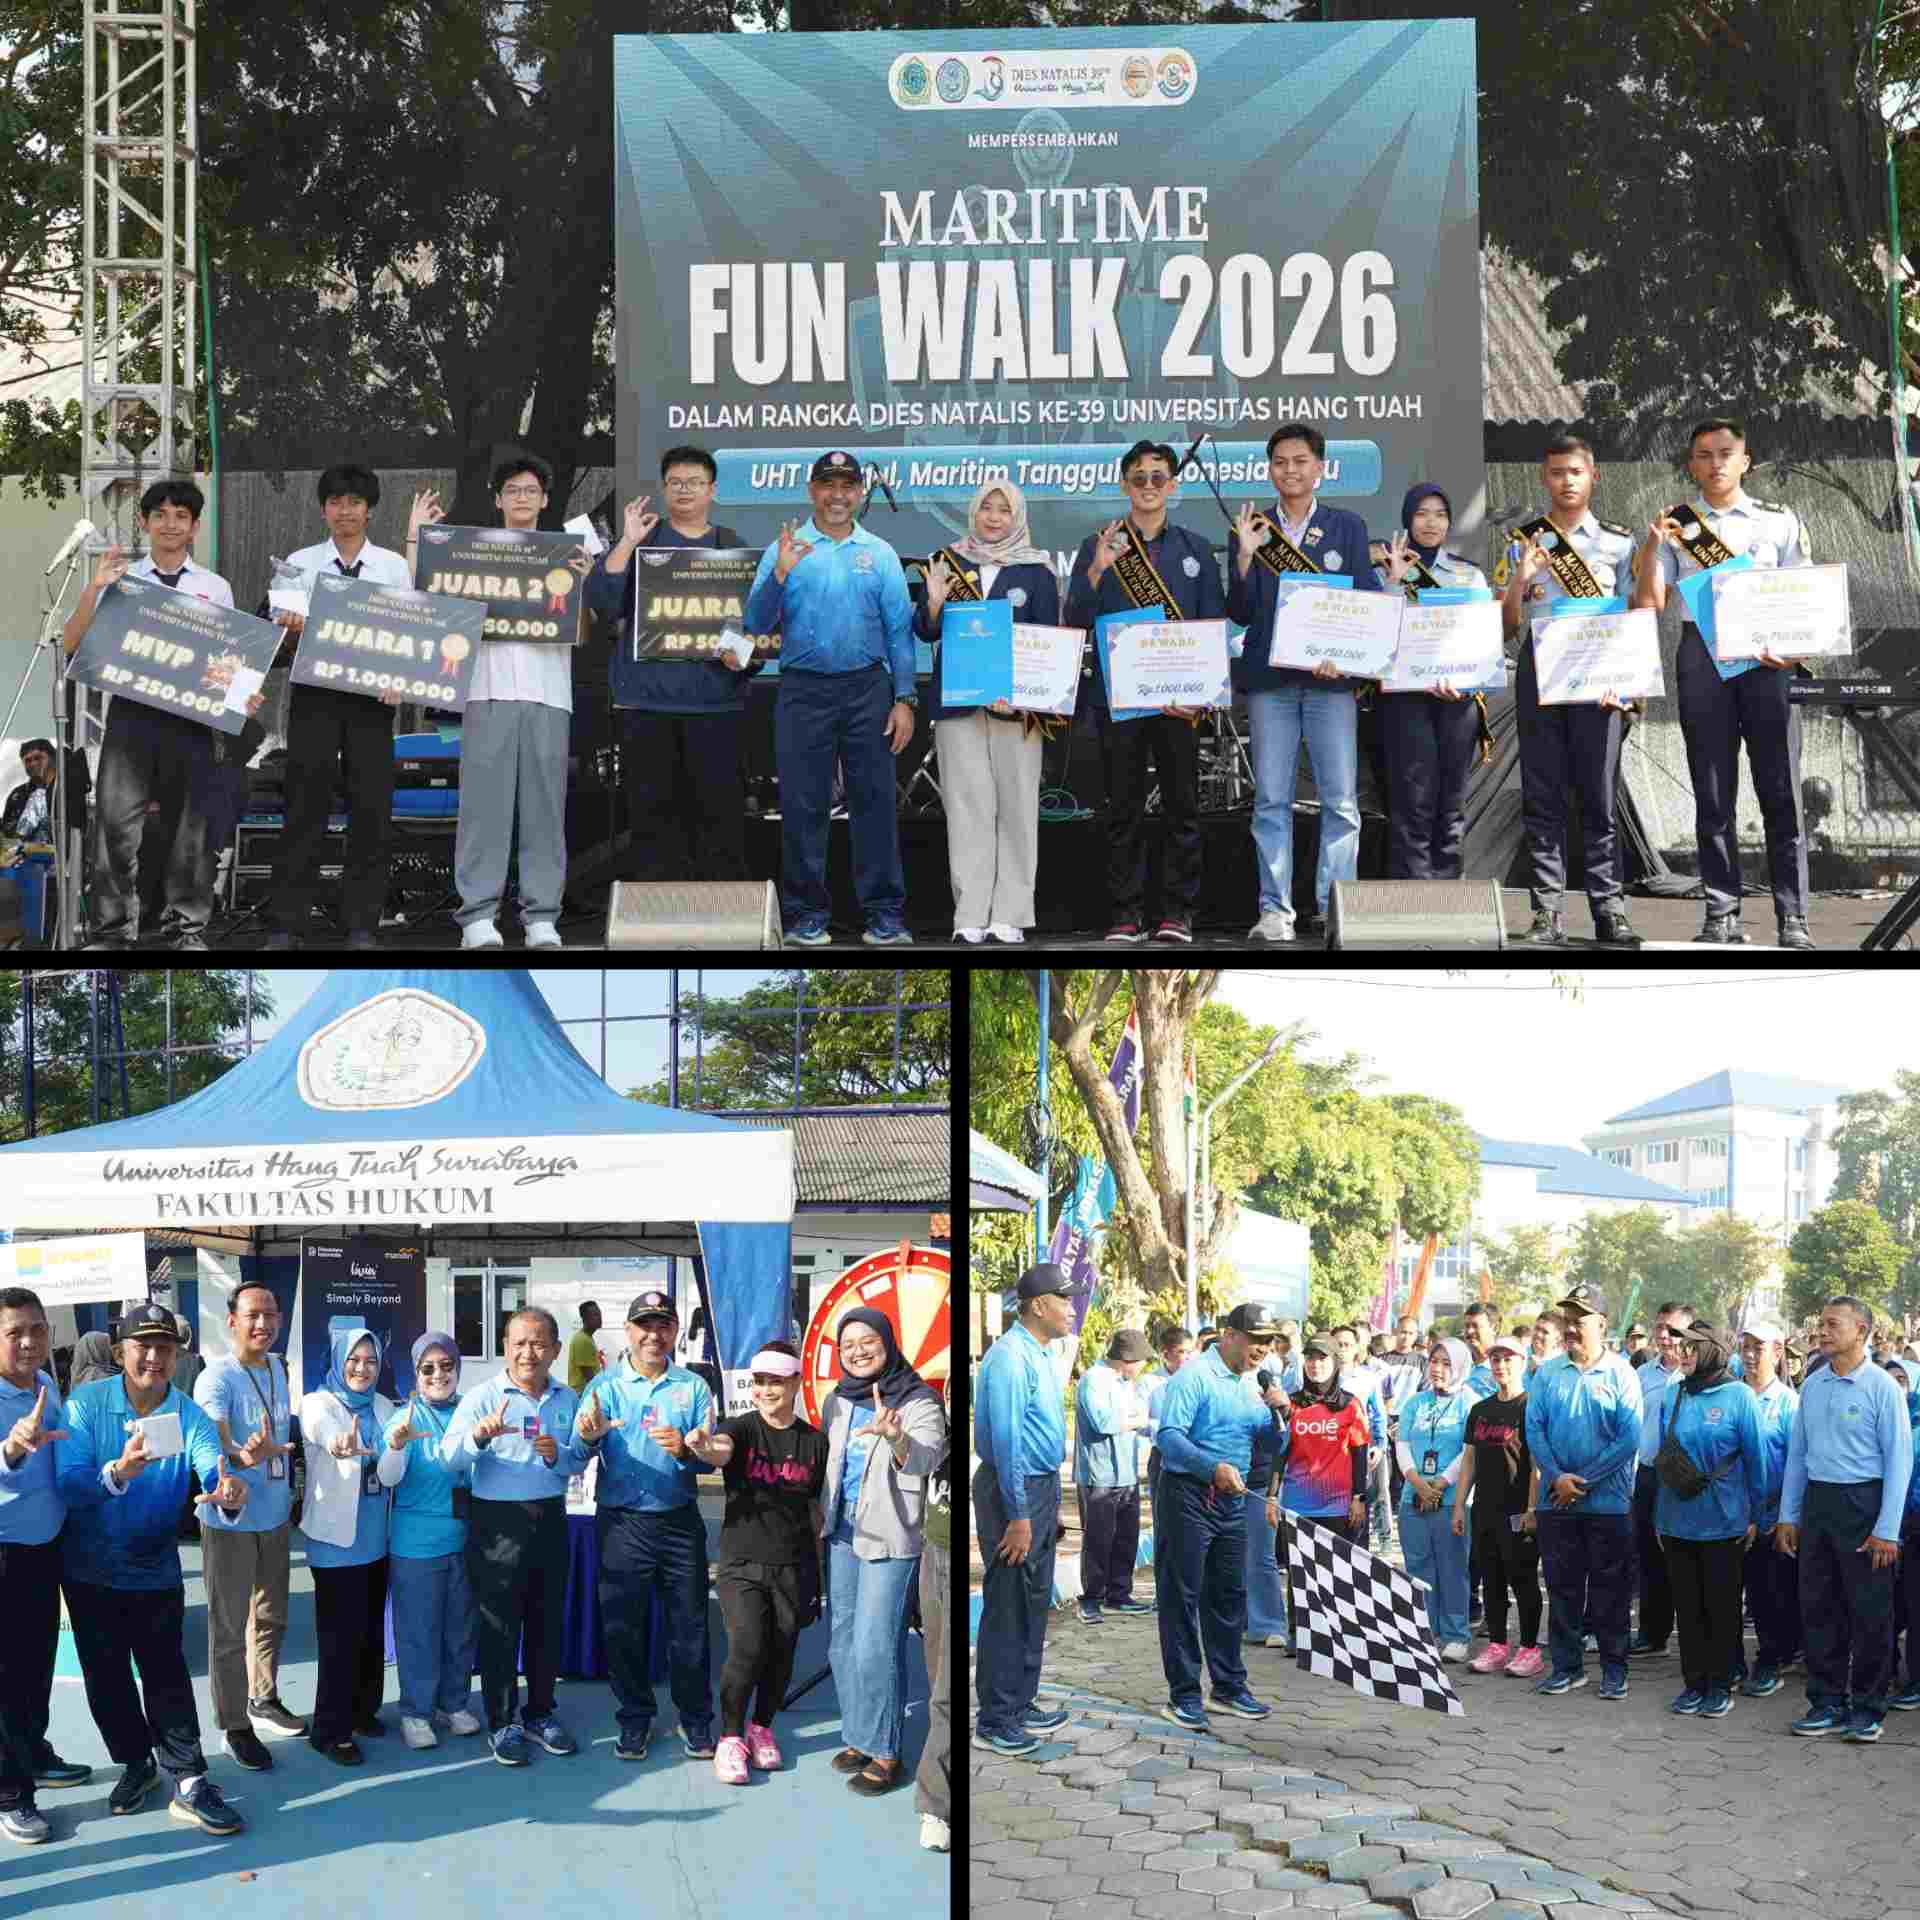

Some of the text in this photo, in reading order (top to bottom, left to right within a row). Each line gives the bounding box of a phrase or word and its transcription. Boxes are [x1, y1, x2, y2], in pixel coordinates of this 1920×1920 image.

[968, 132, 1119, 149] MEMPERSEMBAHKAN
[879, 186, 1209, 247] MARITIME
[688, 249, 1398, 385] FUN WALK 2026
[668, 394, 1423, 429] DALAM RANGKA DIES NATALIS KE-39 UNIVERSITAS HANG TUAH
[751, 463, 800, 489] UHT
[909, 457, 1009, 487] Maritim
[1176, 452, 1270, 483] onesia
[427, 571, 545, 600] JUARA 2
[647, 595, 743, 619] JUARA
[317, 618, 436, 662] JUARA 1
[482, 617, 559, 637] 50.000
[664, 633, 692, 650] RP
[120, 628, 196, 669] MVP
[101, 663, 226, 718] RP 250.000
[313, 660, 457, 703] RP 1.000.000
[102, 1145, 579, 1189] Universitas Hang Tuah Surabaya
[155, 1186, 495, 1219] FAKULTAS HUKUM
[326, 1293, 402, 1307] Simply Beyond
[1295, 1417, 1339, 1436] balé
